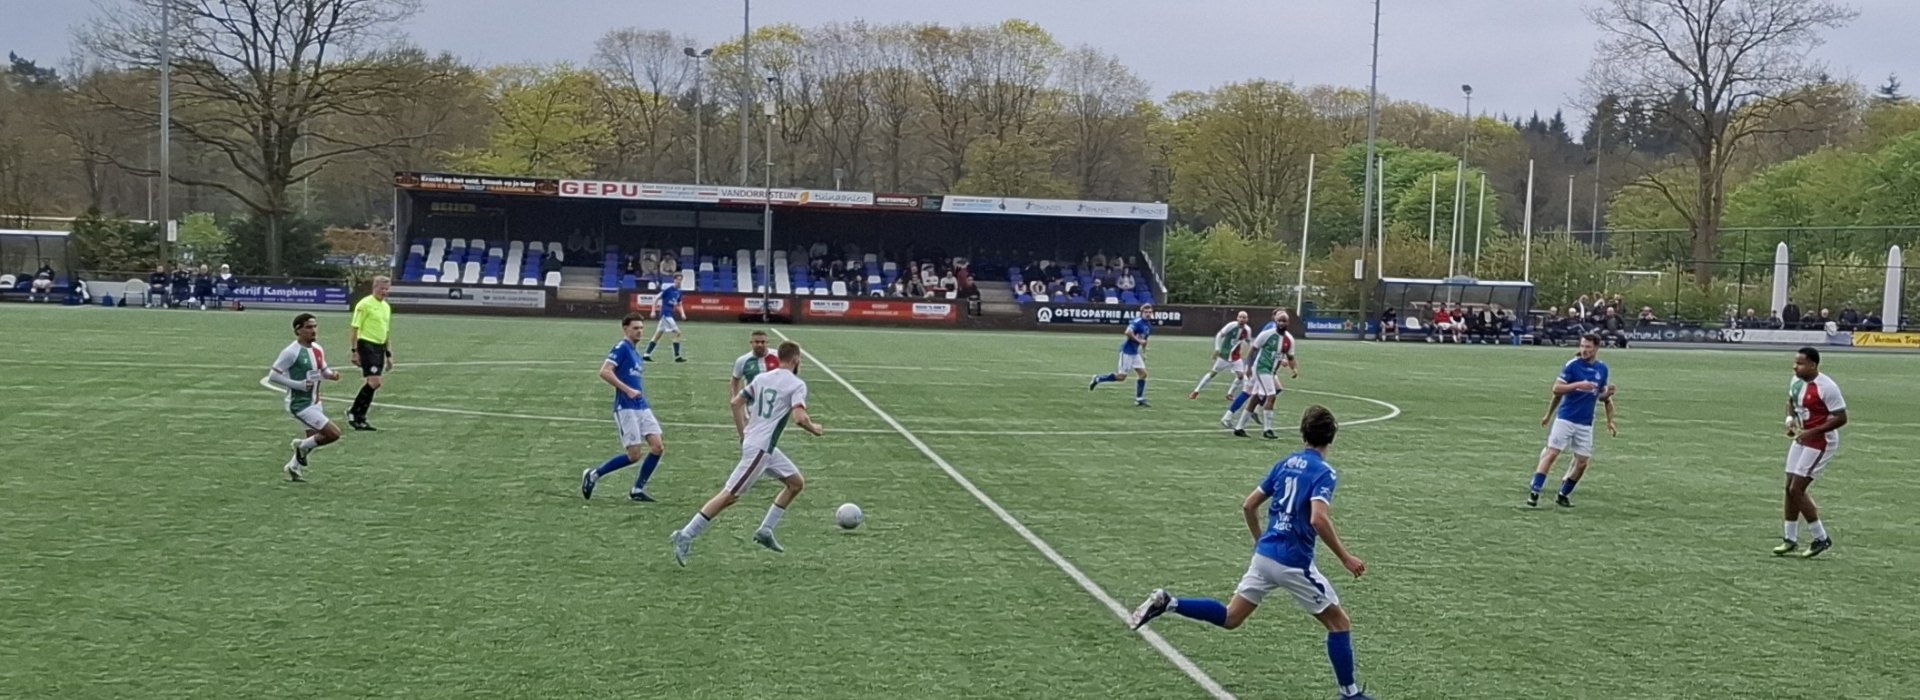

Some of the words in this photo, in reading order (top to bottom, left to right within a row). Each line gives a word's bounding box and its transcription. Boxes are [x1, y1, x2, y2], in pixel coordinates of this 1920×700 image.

[561, 181, 639, 197] GEPU
[264, 286, 317, 298] Kamphorst
[1055, 308, 1120, 319] OSTEOPATHIE
[1123, 311, 1181, 320] ALEANDER
[1307, 321, 1342, 329] Heineken
[758, 387, 777, 419] 13
[1279, 476, 1299, 514] 11
